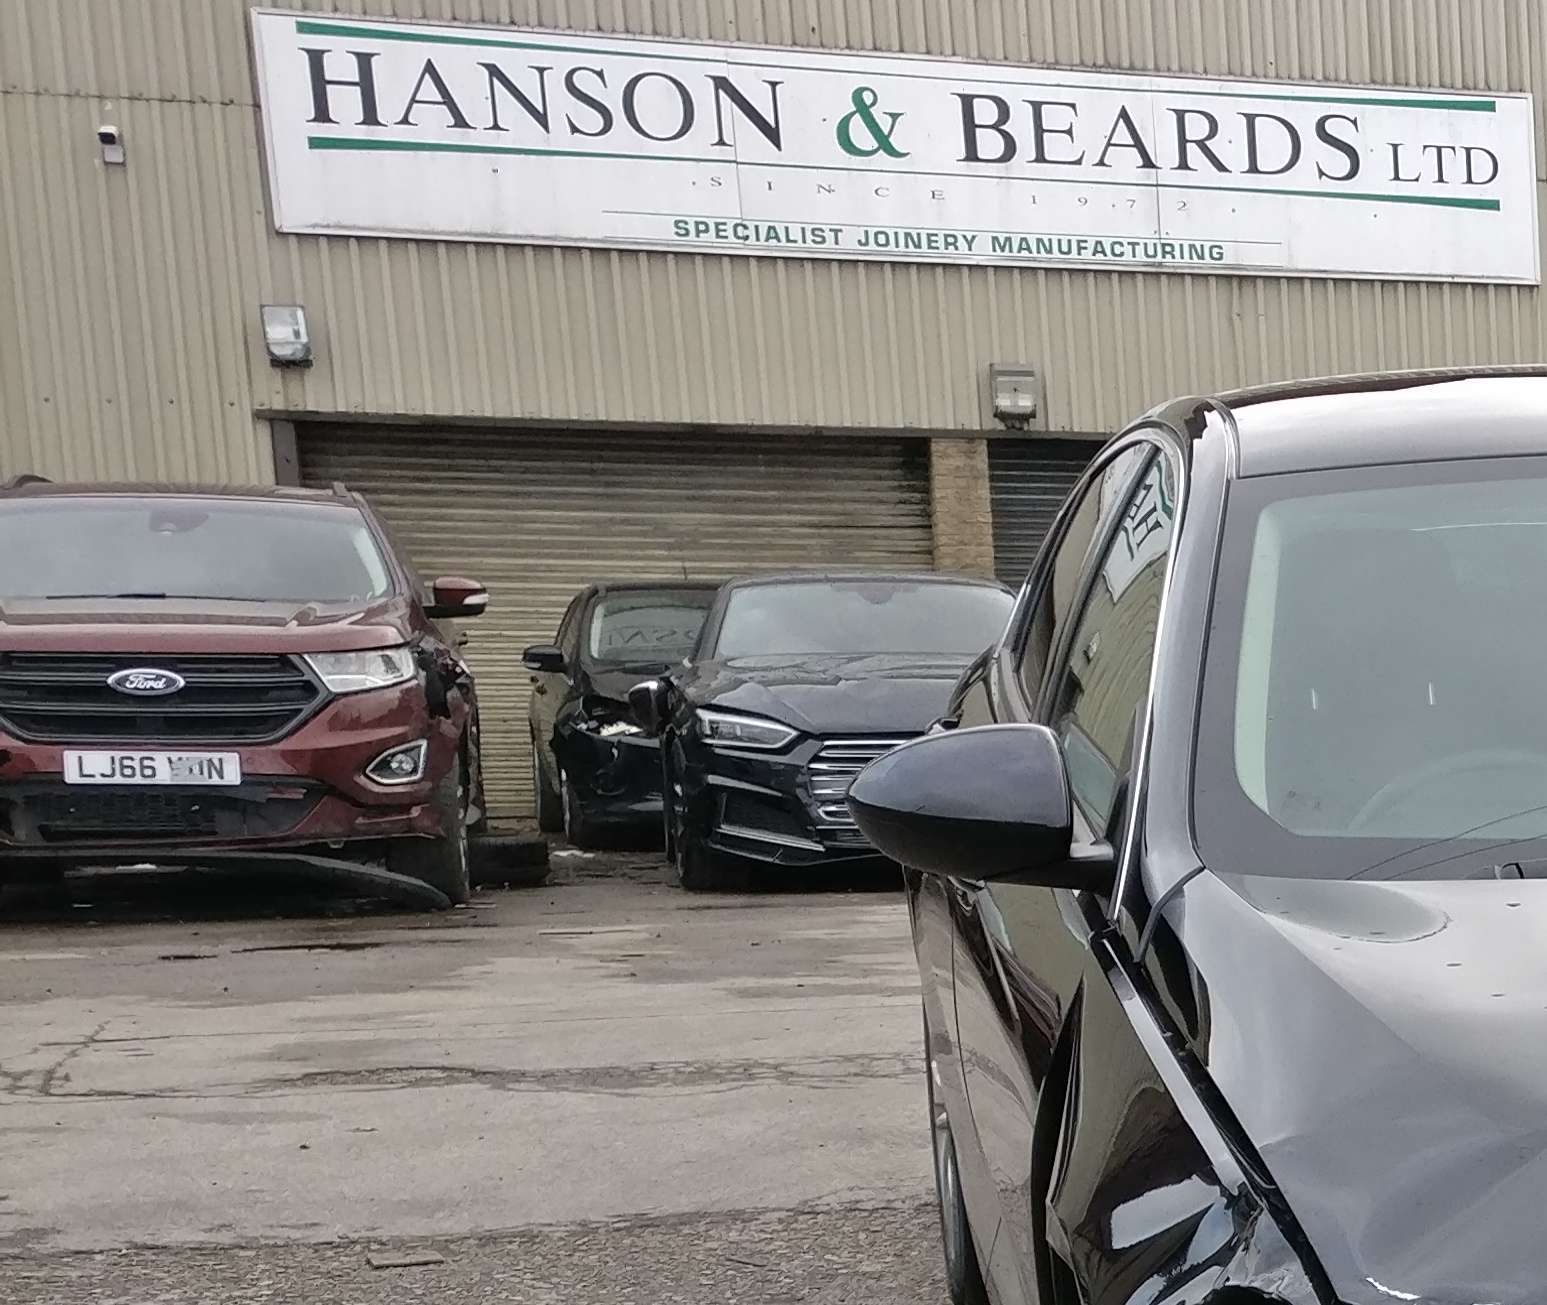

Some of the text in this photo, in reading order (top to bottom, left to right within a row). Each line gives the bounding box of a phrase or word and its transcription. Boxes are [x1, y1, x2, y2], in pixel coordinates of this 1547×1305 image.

[297, 46, 1500, 186] HANSON & BEARDS LTD
[710, 176, 945, 201] SINCE
[673, 219, 1225, 262] SPECIALIST JOINERY MANUFACTURING
[125, 673, 167, 690] Ford
[77, 755, 157, 779] LJ66
